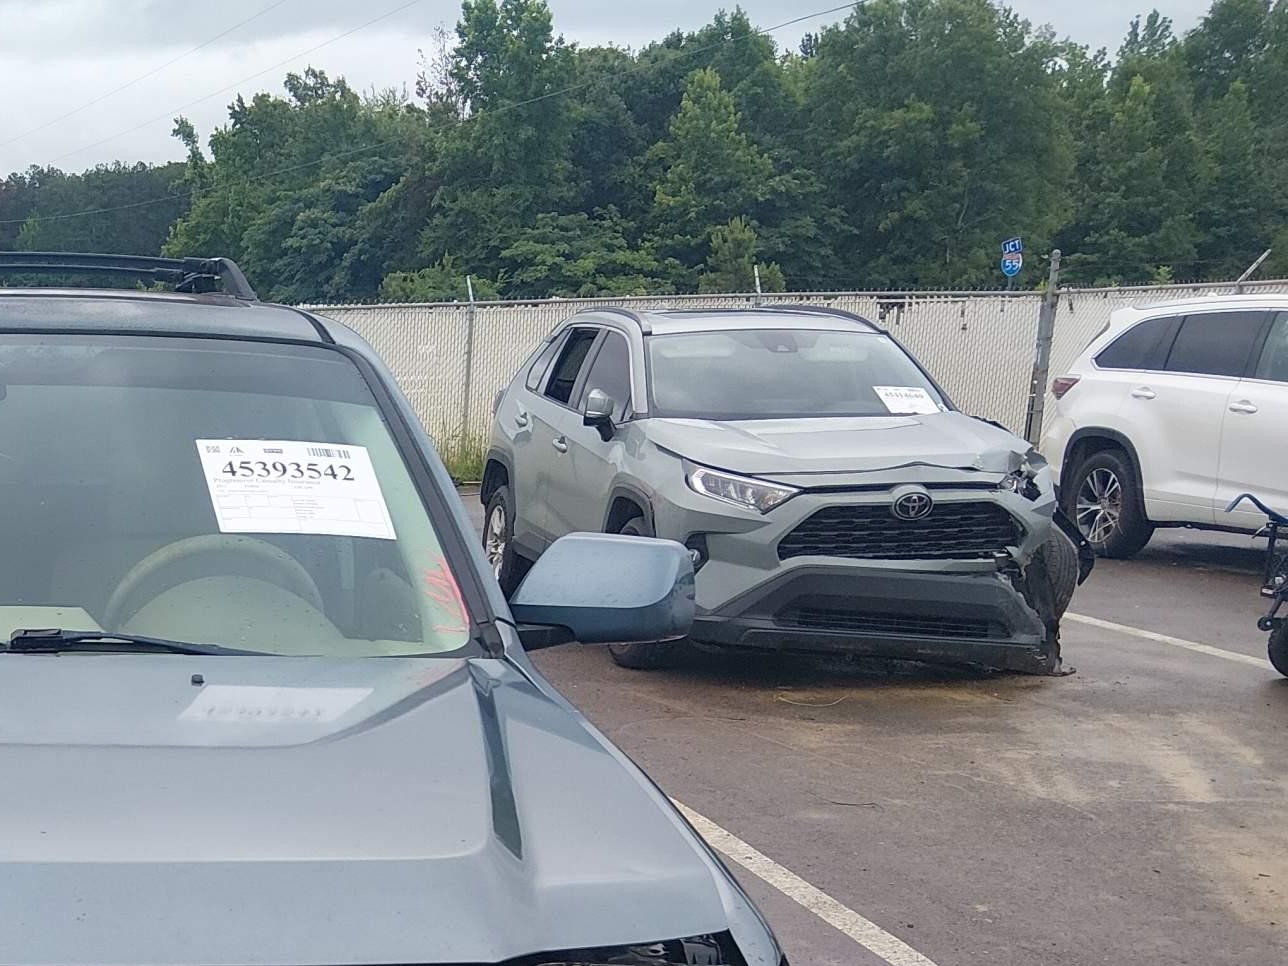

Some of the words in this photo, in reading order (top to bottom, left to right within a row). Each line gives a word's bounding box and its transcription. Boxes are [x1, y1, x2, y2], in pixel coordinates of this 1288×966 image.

[1004, 240, 1019, 253] JCT
[1005, 259, 1019, 270] 55
[222, 460, 355, 480] 45393542
